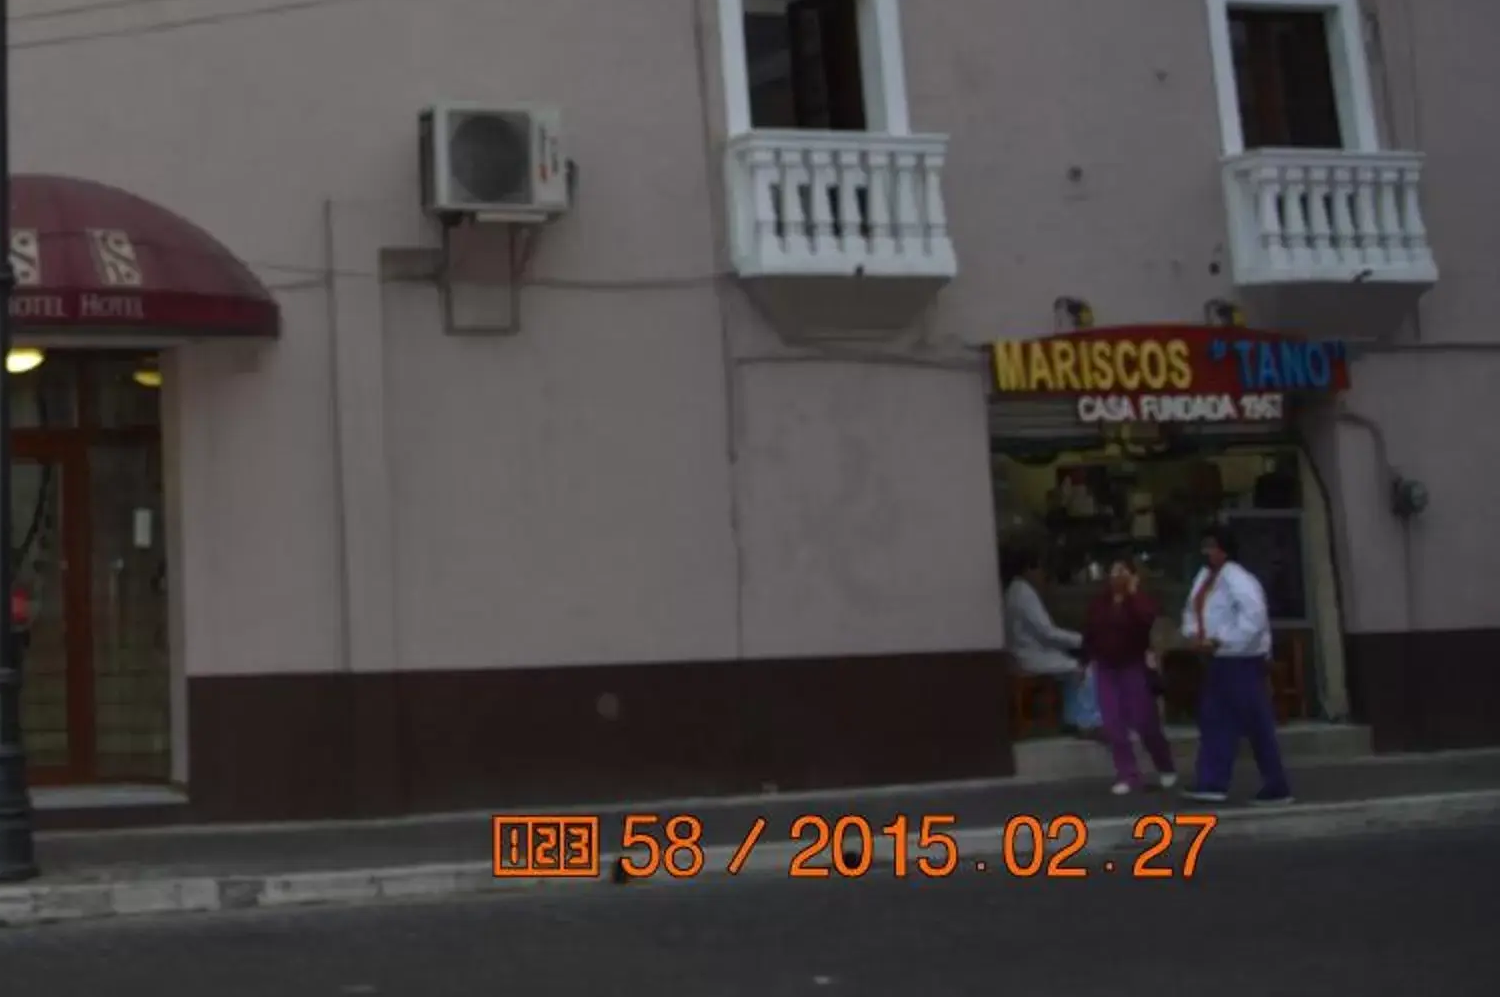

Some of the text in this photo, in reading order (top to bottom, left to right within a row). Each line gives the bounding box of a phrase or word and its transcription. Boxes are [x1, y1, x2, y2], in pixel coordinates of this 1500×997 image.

[994, 339, 1192, 391] MARISCOS
[1077, 396, 1136, 422] CASA
[1140, 395, 1237, 421] FUNDADA
